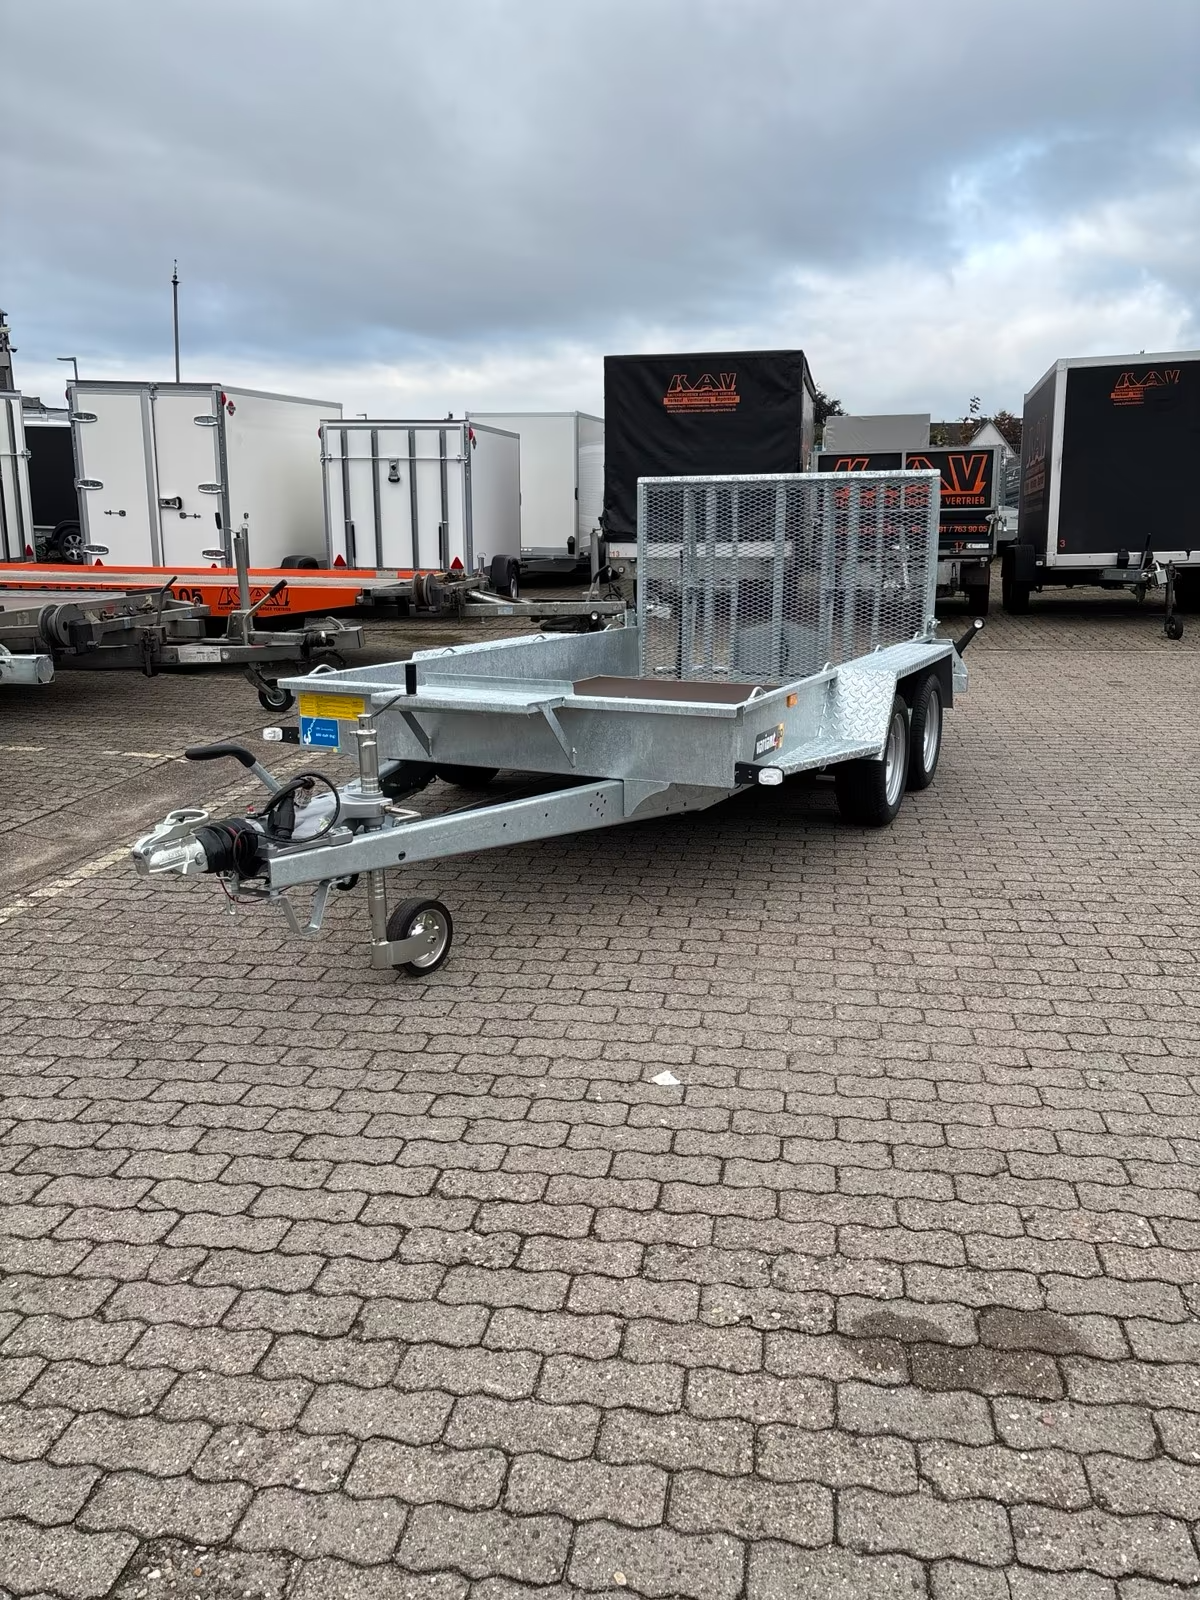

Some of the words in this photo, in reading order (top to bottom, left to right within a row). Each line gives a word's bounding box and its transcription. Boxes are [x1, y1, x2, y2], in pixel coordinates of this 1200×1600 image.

[667, 372, 737, 393] KAV
[1115, 369, 1181, 388] KAV
[945, 496, 986, 505] VERTRIEB
[954, 525, 967, 533] 763
[968, 525, 977, 533] 90
[978, 525, 988, 533] 05
[1059, 539, 1067, 548] 3
